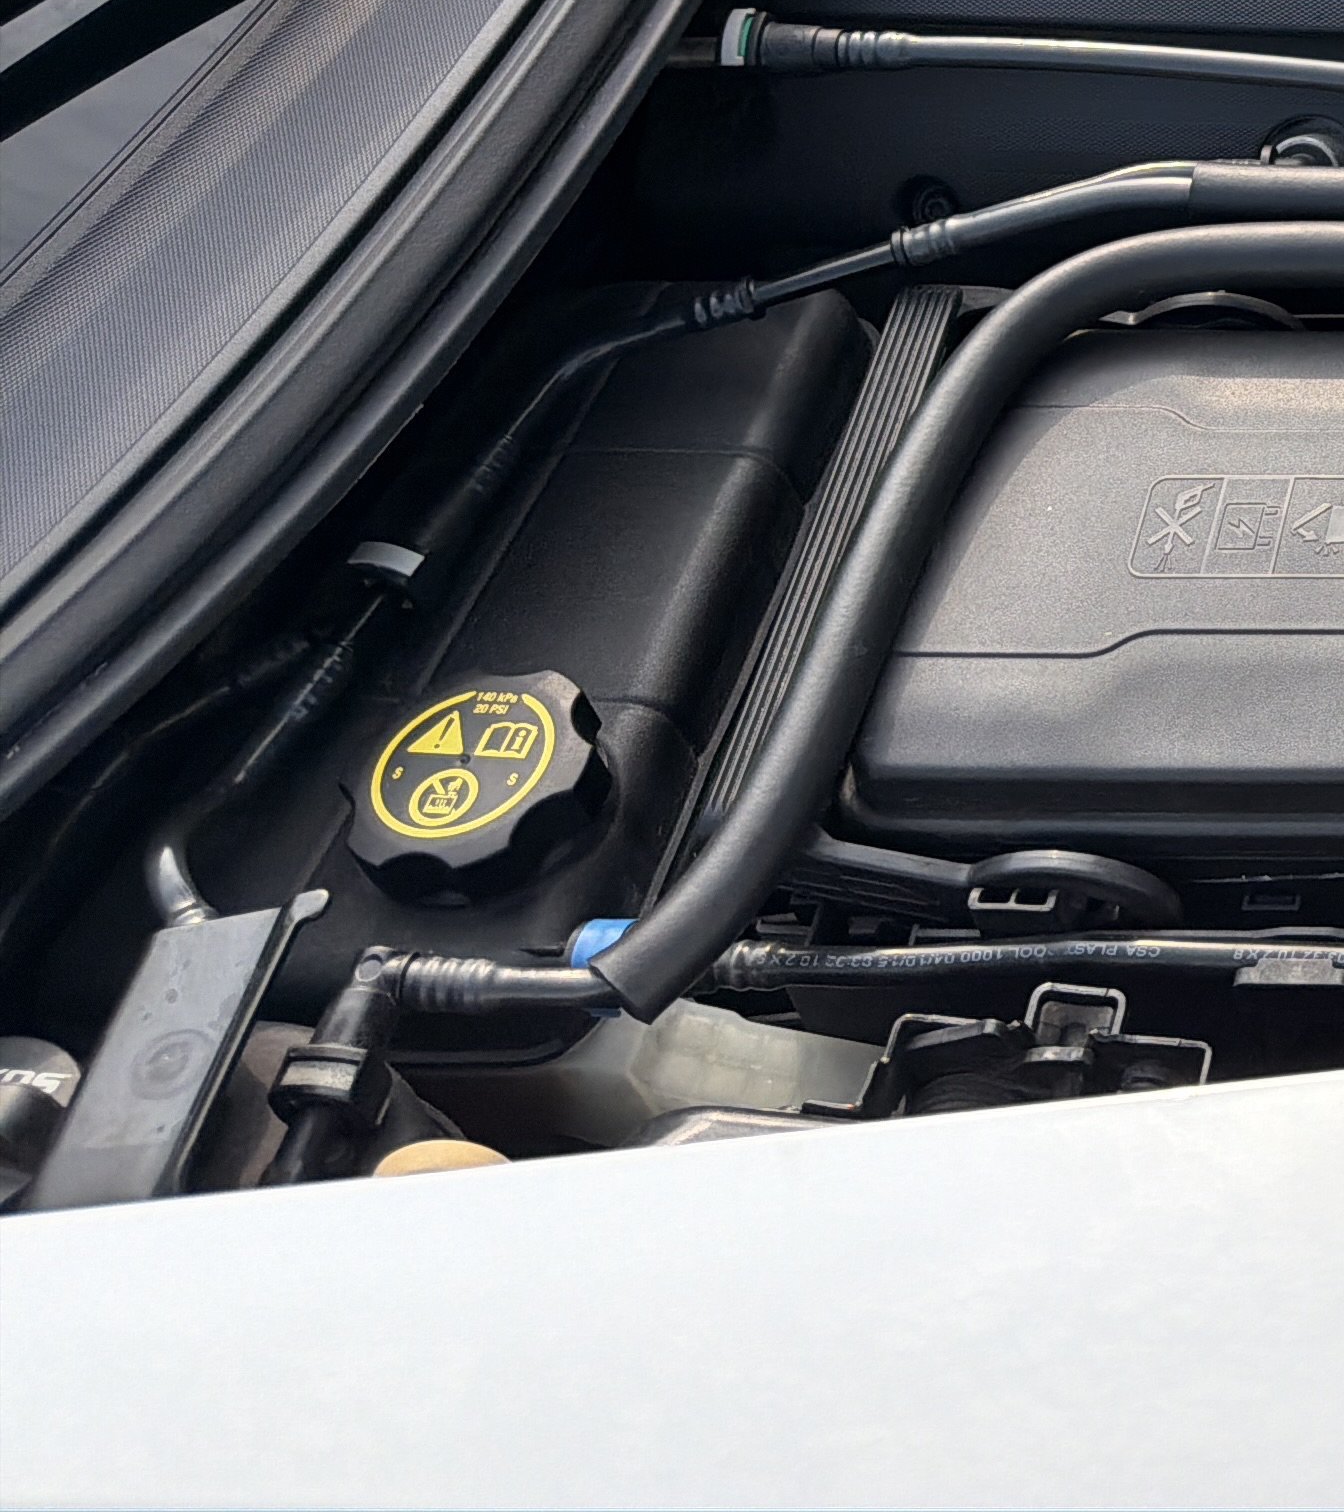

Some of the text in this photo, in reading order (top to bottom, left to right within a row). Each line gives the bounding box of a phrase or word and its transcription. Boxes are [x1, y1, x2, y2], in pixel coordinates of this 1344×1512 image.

[476, 692, 518, 704] 140 kPa
[473, 704, 510, 715] 20 PSI
[960, 947, 1002, 962] 1000
[1127, 944, 1161, 958] CSA
